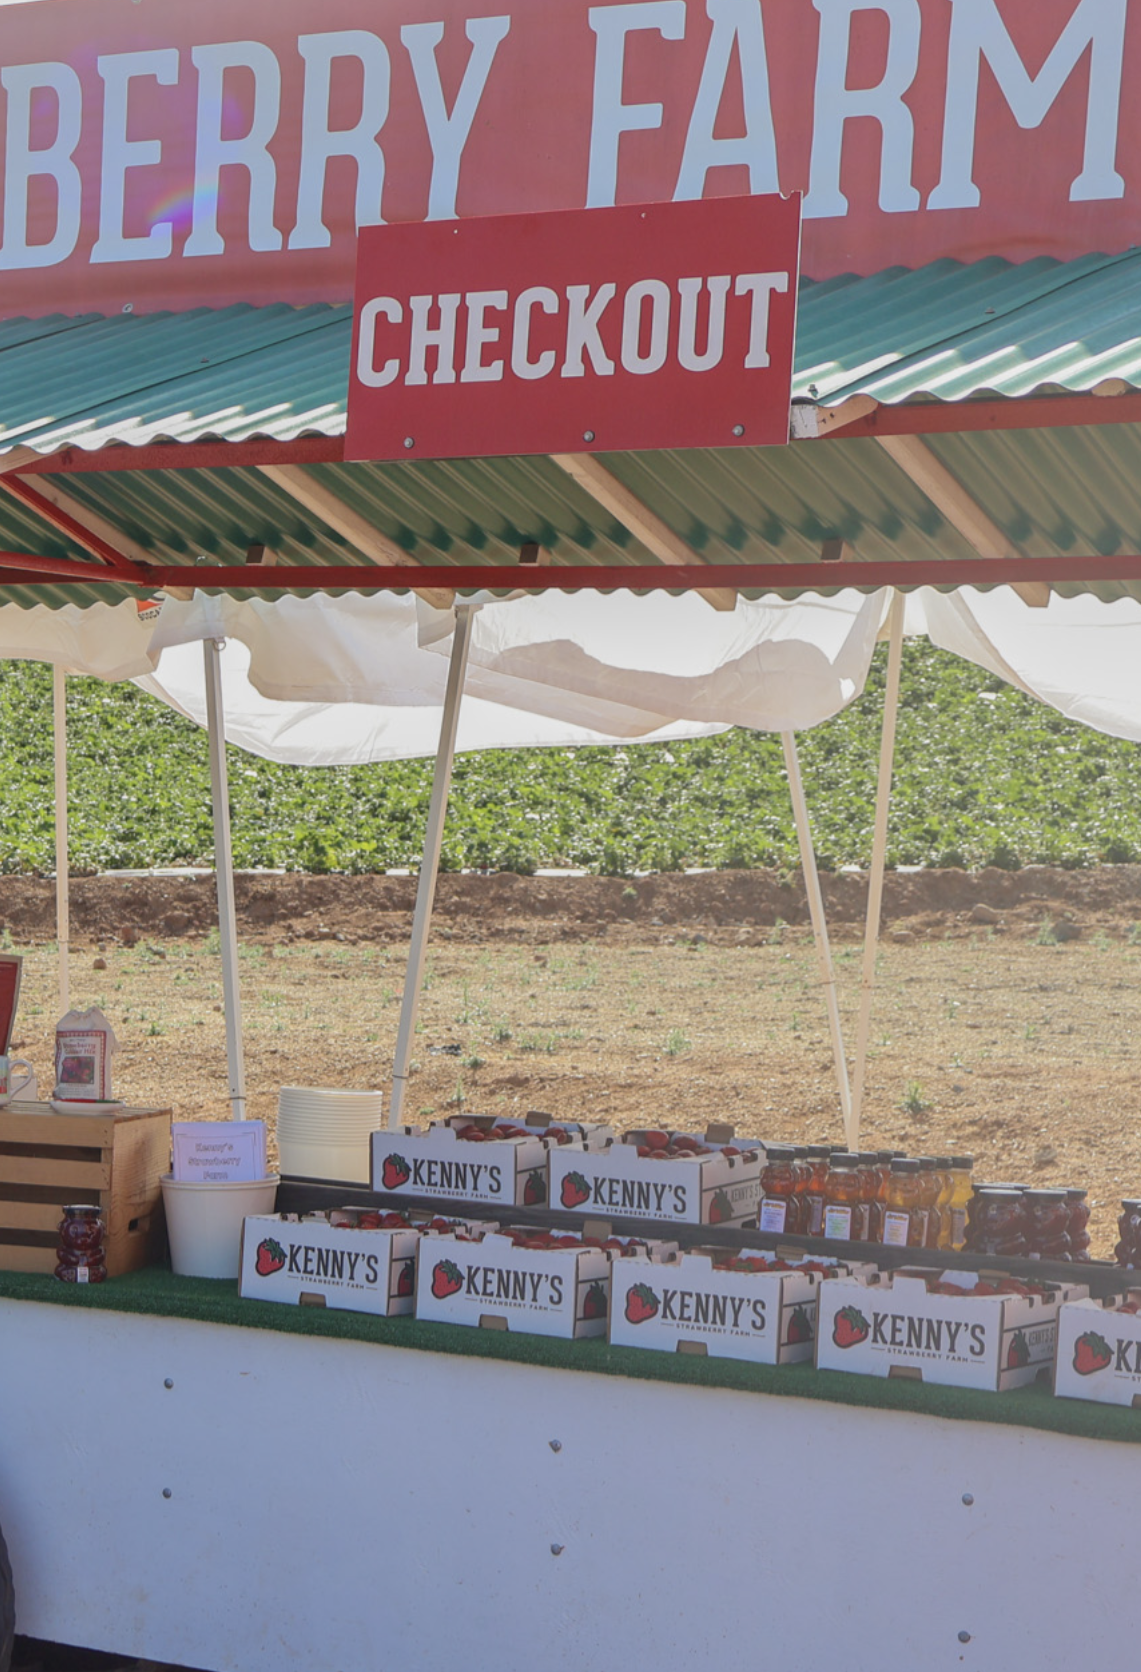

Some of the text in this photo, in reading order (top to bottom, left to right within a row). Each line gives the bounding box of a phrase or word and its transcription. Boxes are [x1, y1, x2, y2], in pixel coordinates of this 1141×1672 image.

[585, 0, 1128, 219] FARM
[356, 270, 790, 389] CHECKOUT
[412, 1158, 502, 1194] KENNY'S
[425, 1188, 469, 1197] STRAWBERRY
[592, 1176, 687, 1214] KENNY'S
[606, 1207, 651, 1217] STRAWBERRY
[287, 1243, 379, 1284] KENNY'S
[300, 1276, 365, 1290] STRAWBERRY FARM
[465, 1265, 563, 1305] KENNY'S
[479, 1298, 549, 1311] STRAWBERRY FARM
[661, 1288, 766, 1331] KENNY'S
[676, 1323, 751, 1337] STRAWBERRY FARM
[871, 1312, 985, 1357] KENNY'S
[887, 1347, 968, 1363] STRAWBERRY FARM
